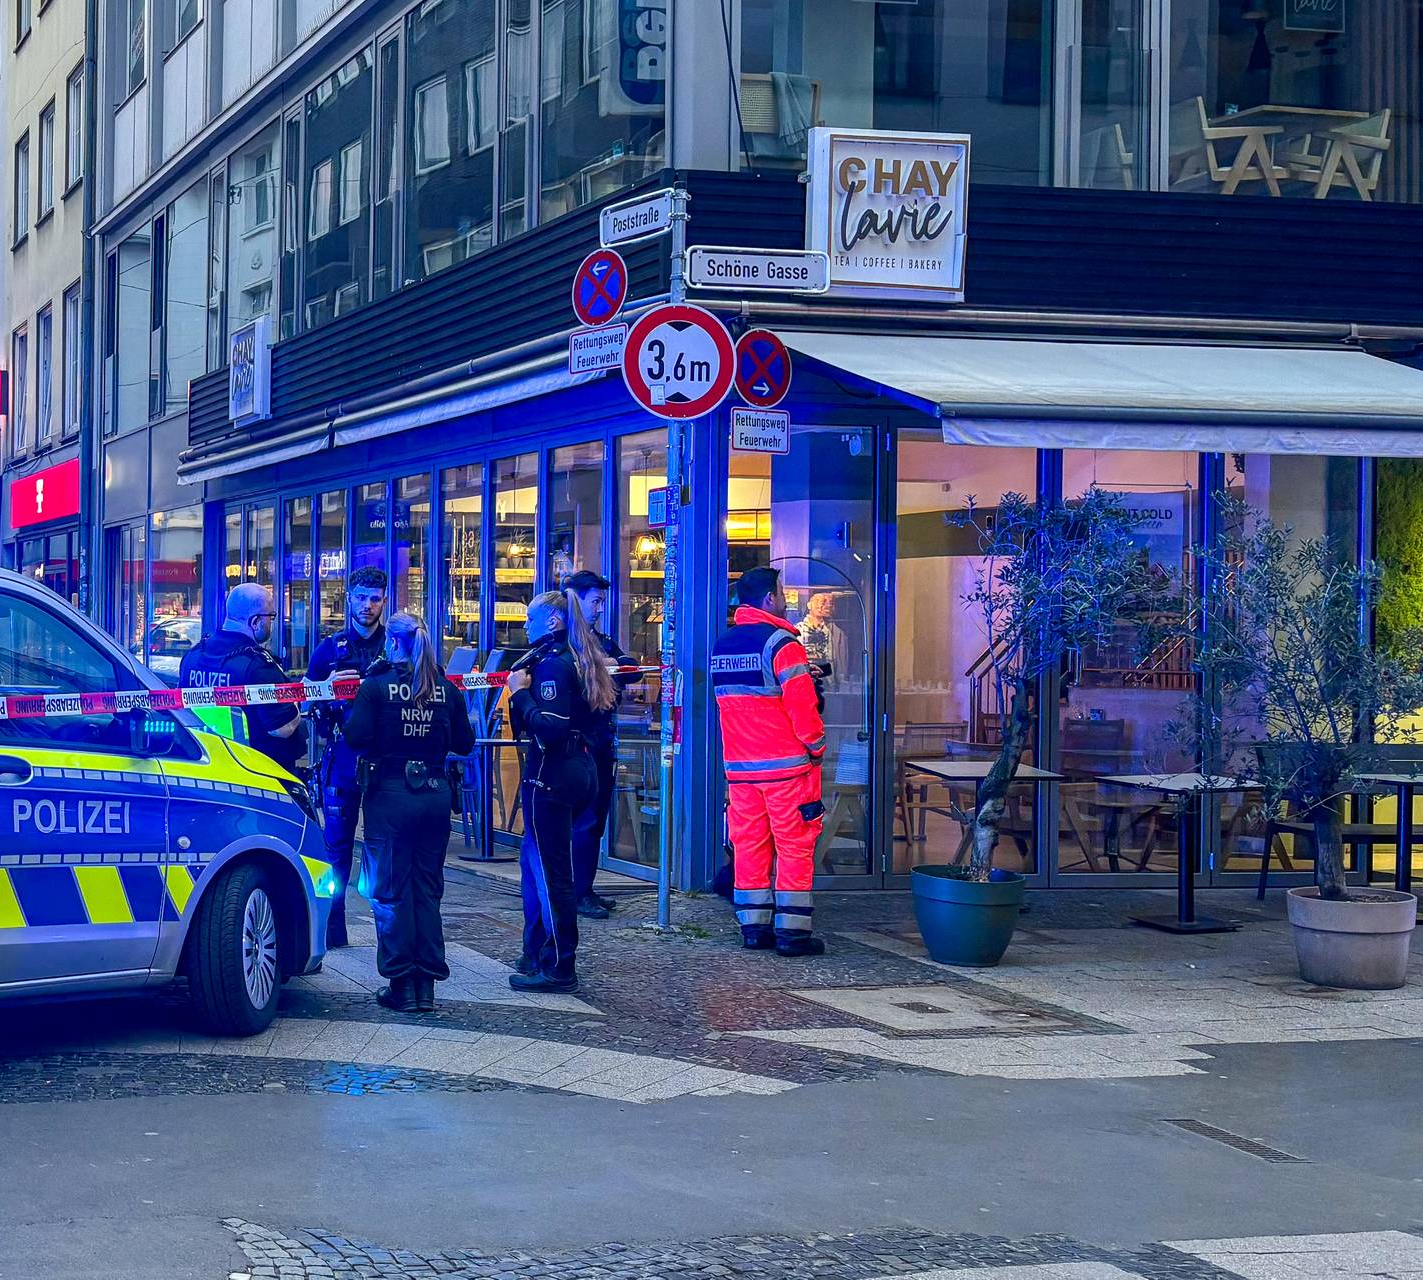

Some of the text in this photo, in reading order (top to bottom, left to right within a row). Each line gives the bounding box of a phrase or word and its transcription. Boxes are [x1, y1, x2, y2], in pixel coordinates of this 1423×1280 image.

[839, 156, 959, 198] CHAY
[612, 206, 660, 235] Poststraße
[840, 180, 954, 251] lavie
[707, 258, 809, 281] Schöne Gasse
[835, 255, 943, 271] TEA COFFEE BAKERY
[573, 329, 624, 351] Rettungsweg
[577, 350, 620, 369] Feuerwehr
[735, 413, 786, 431] Rettungsweg
[739, 432, 782, 449] Feuerwehr
[388, 683, 446, 703] POEI
[401, 708, 434, 722] NRW
[403, 723, 431, 737] DHF
[13, 798, 130, 834] POLIZEI
